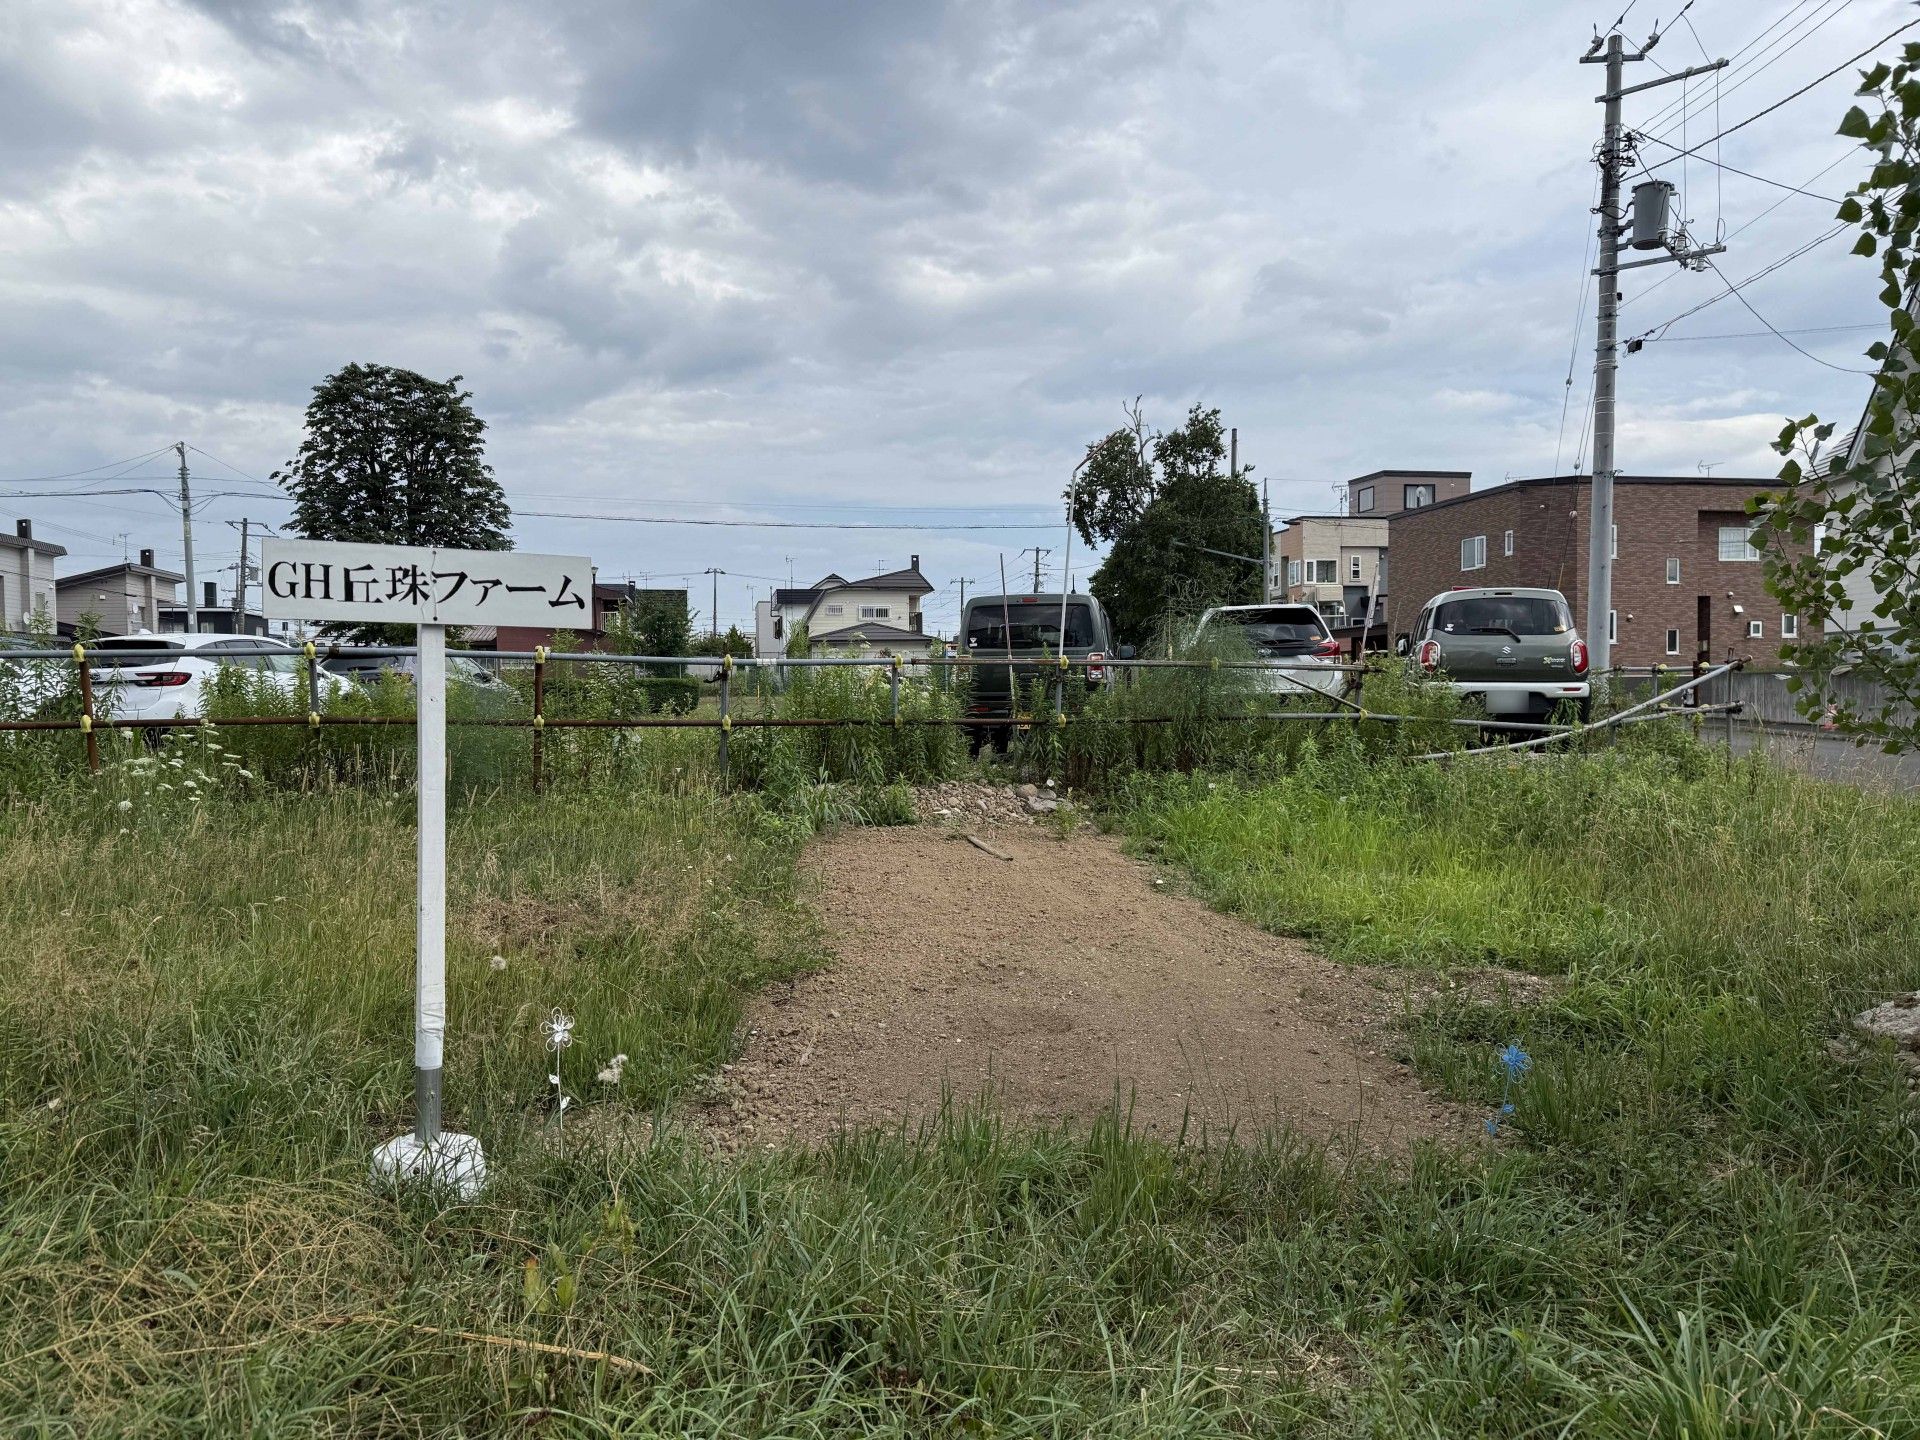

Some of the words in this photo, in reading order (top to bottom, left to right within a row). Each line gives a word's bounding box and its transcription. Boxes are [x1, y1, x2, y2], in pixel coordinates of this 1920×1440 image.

[268, 561, 585, 610] GH丘珠ファーム
